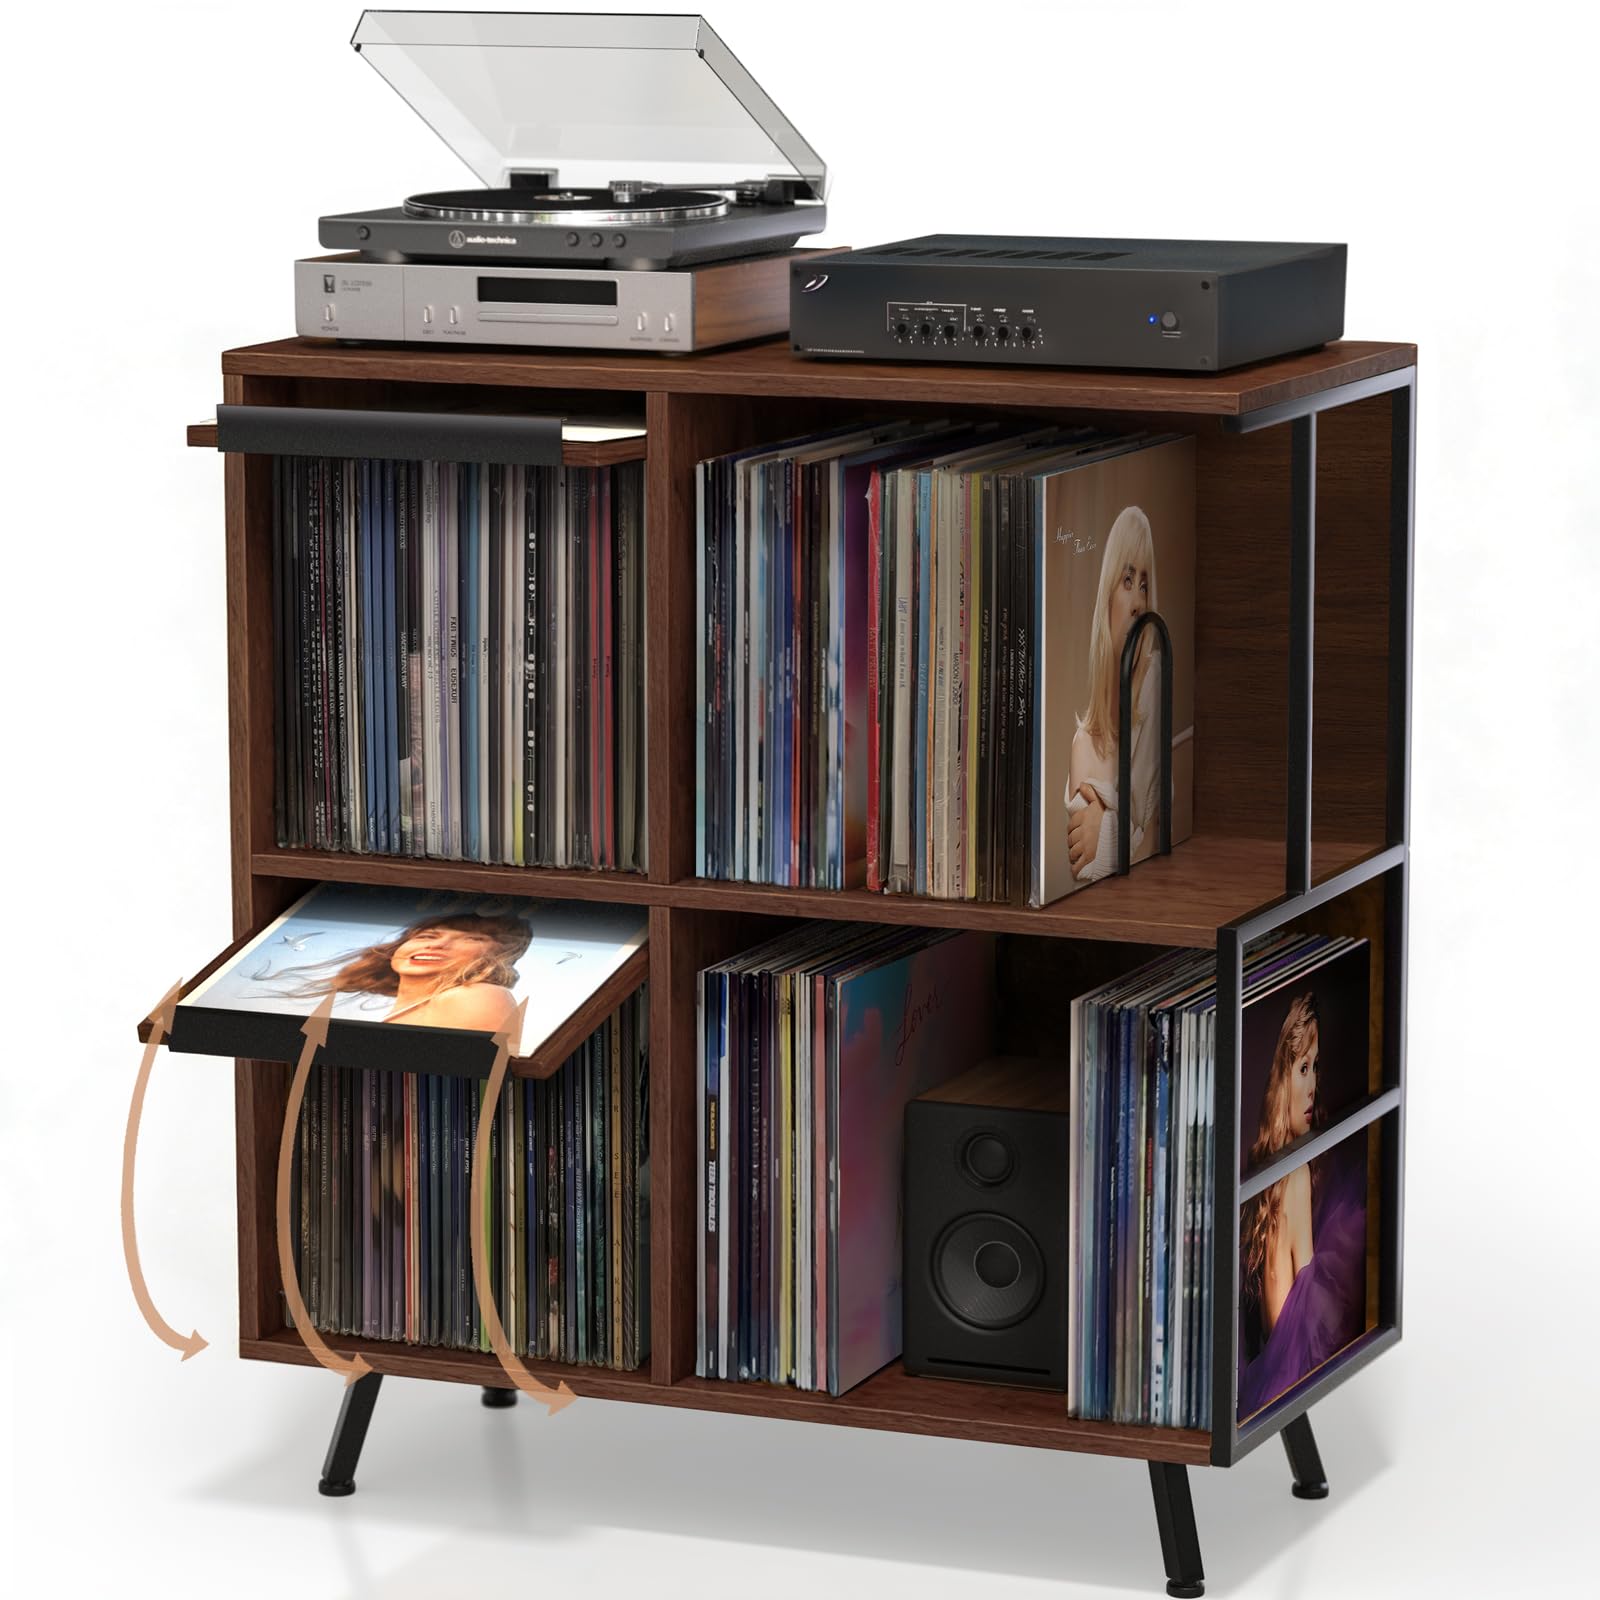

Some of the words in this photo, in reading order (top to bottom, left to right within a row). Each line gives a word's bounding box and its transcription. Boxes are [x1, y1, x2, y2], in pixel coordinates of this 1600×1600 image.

[465, 235, 518, 246] audio-technica
[1017, 627, 1027, 693] XXXTENTACION
[896, 982, 946, 1067] Lover
